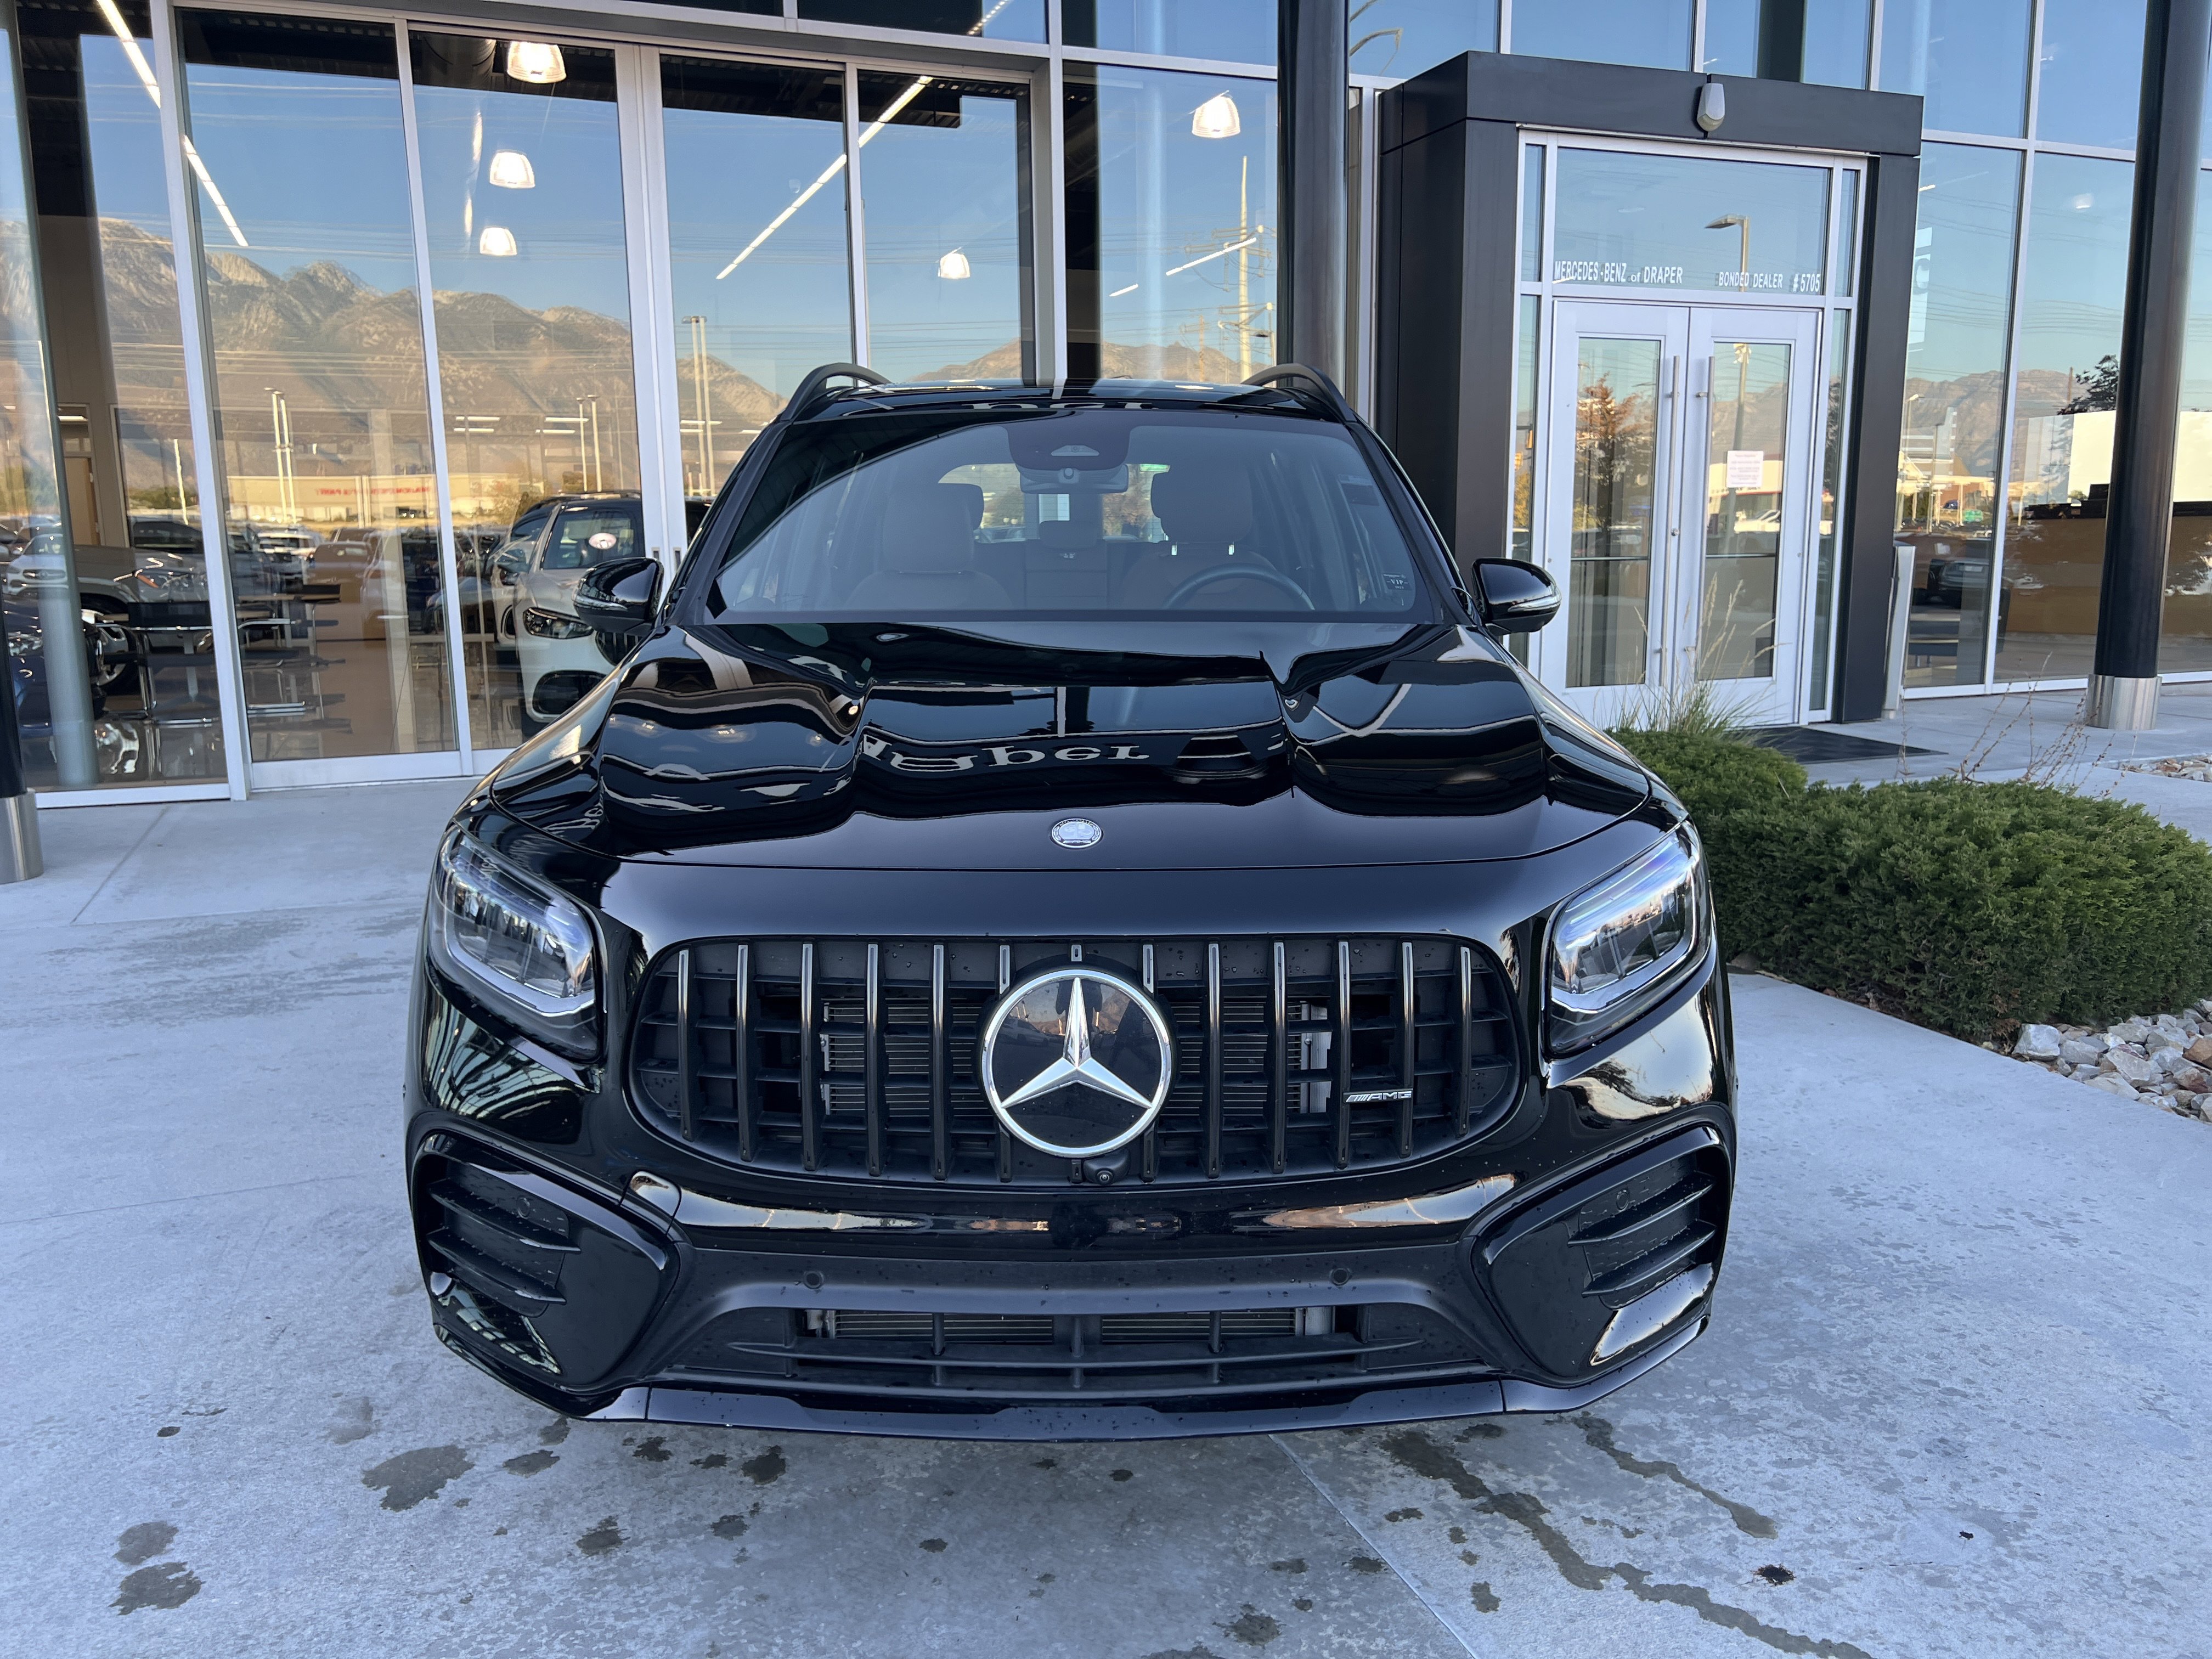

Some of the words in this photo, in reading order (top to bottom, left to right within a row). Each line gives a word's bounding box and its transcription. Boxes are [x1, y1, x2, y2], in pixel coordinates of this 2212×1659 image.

[1630, 272, 1640, 283] of
[1644, 266, 1683, 284] DRAPER
[1719, 272, 1750, 286] BONDED
[1753, 273, 1783, 289] DEALER
[1365, 1091, 1412, 1102] AMG
